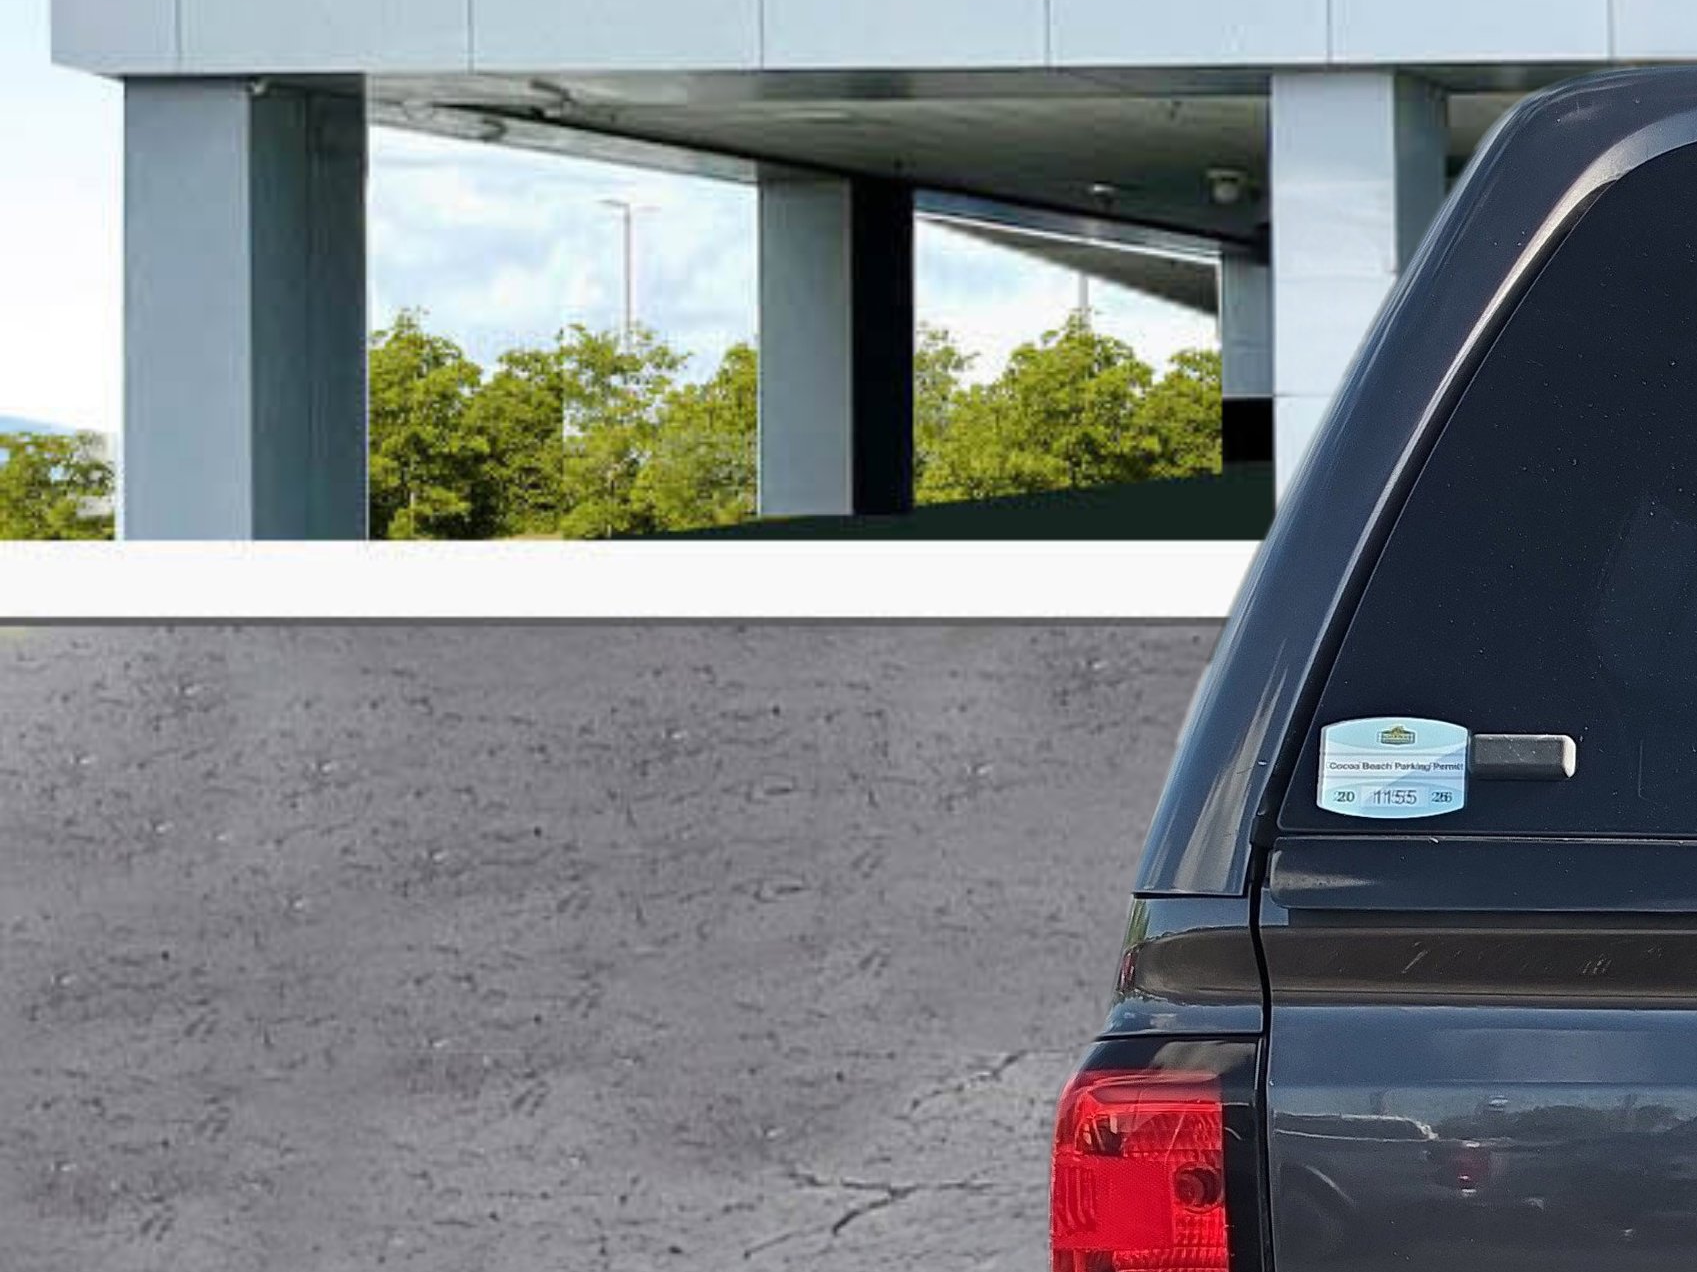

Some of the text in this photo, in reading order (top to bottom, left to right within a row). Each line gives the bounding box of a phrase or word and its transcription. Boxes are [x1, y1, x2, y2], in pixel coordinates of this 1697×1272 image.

[1329, 762, 1360, 770] Cocoa
[1362, 762, 1392, 770] Beach
[1394, 762, 1431, 772] Parking
[1373, 789, 1417, 805] 1155
